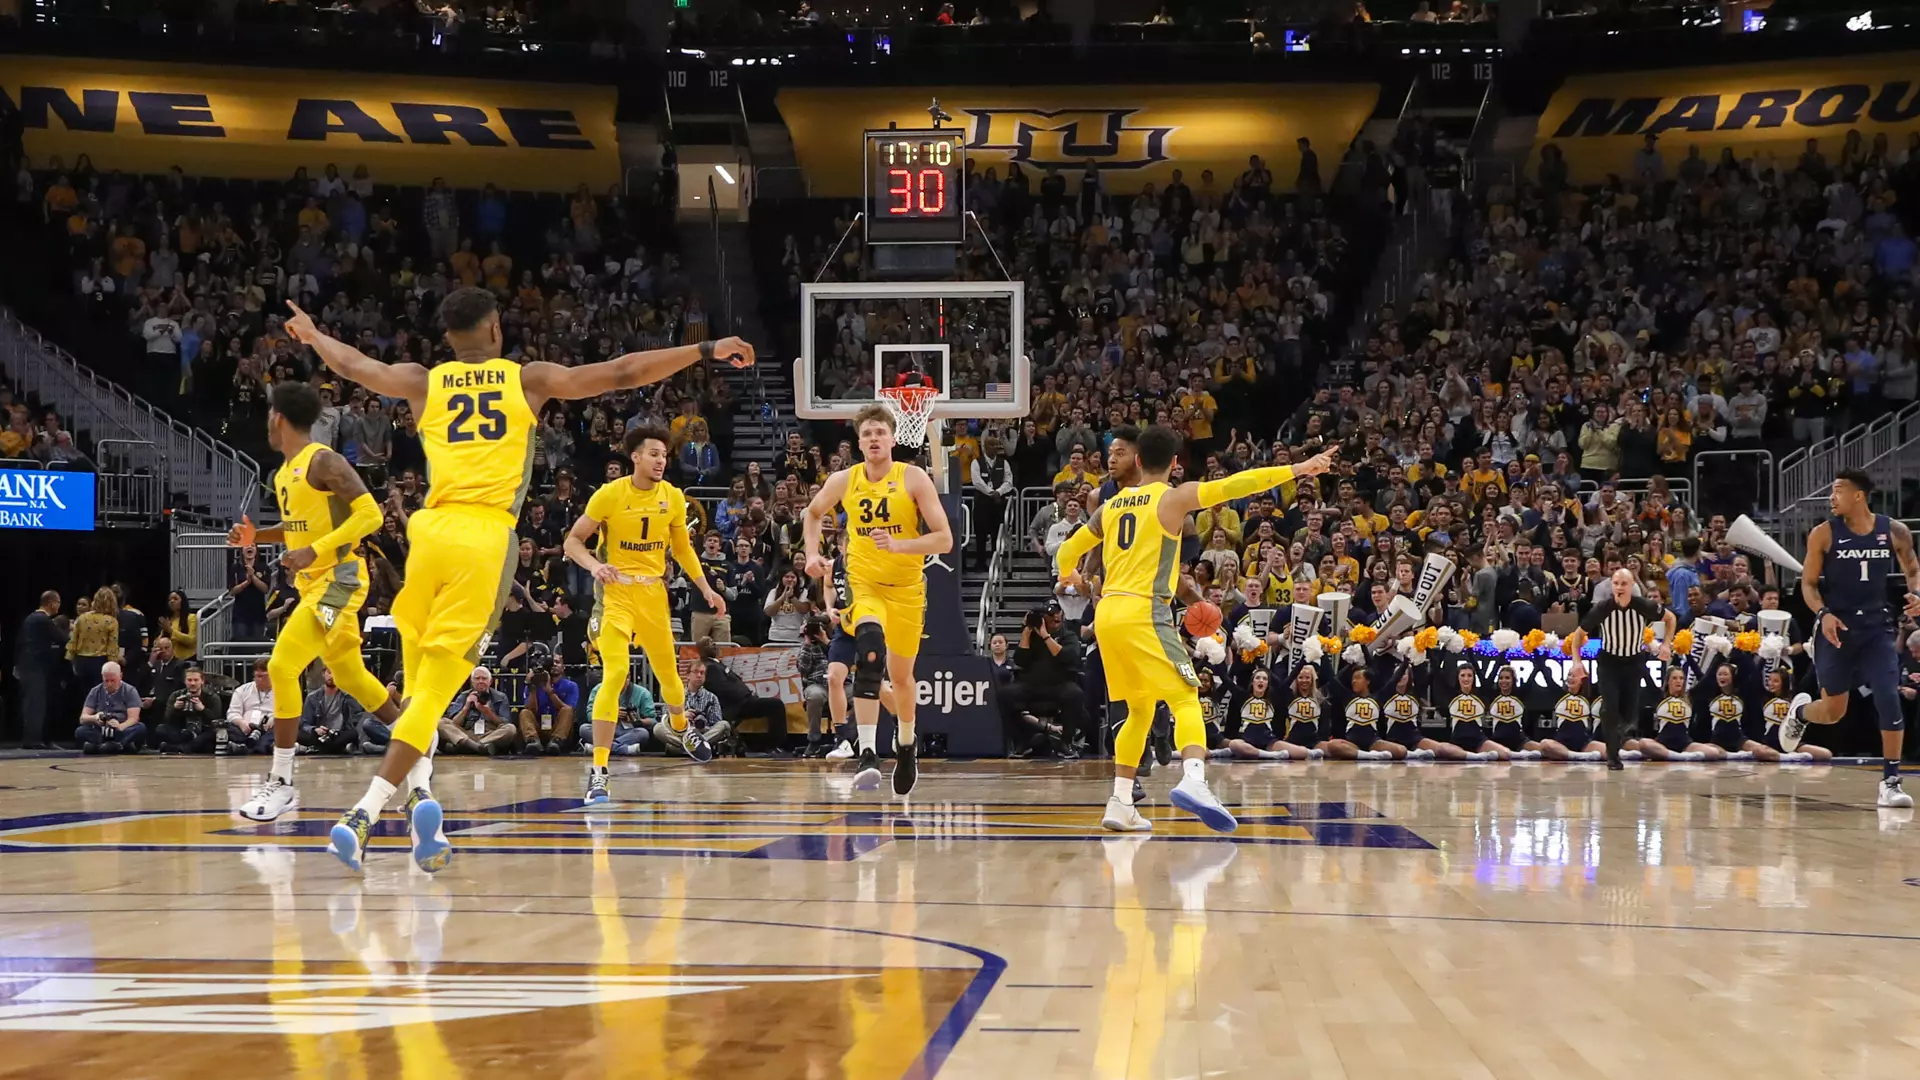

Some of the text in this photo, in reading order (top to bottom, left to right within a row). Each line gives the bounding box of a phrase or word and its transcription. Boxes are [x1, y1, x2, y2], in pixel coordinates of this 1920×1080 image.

[668, 71, 687, 87] 110
[710, 71, 728, 86] 112
[1431, 63, 1450, 79] 112
[1473, 63, 1492, 79] 113
[287, 98, 596, 149] ARE
[889, 142, 951, 165] 17:10
[889, 169, 944, 214] 30
[443, 370, 505, 388] McEWEN
[447, 391, 507, 443] 25
[281, 487, 291, 516] 2
[1110, 495, 1151, 509] HOWARD
[859, 498, 890, 523] 34
[641, 517, 649, 540] 1
[1117, 512, 1137, 551] 0
[620, 541, 664, 552] MARQUETTE
[1836, 549, 1890, 559] XAVIER
[1420, 563, 1442, 592] OUT
[1860, 561, 1869, 581] 1
[1275, 589, 1291, 603] 33
[1293, 616, 1311, 645] OUT
[916, 671, 990, 714] eijer
[1250, 703, 1267, 719] MU
[1296, 701, 1314, 718] MU
[1356, 702, 1373, 720] MU
[1395, 699, 1412, 716] MU
[1458, 699, 1476, 716] MU
[1497, 701, 1515, 717] MU
[1566, 699, 1584, 716] MU
[1668, 701, 1686, 717] MU
[1719, 698, 1737, 716] MU
